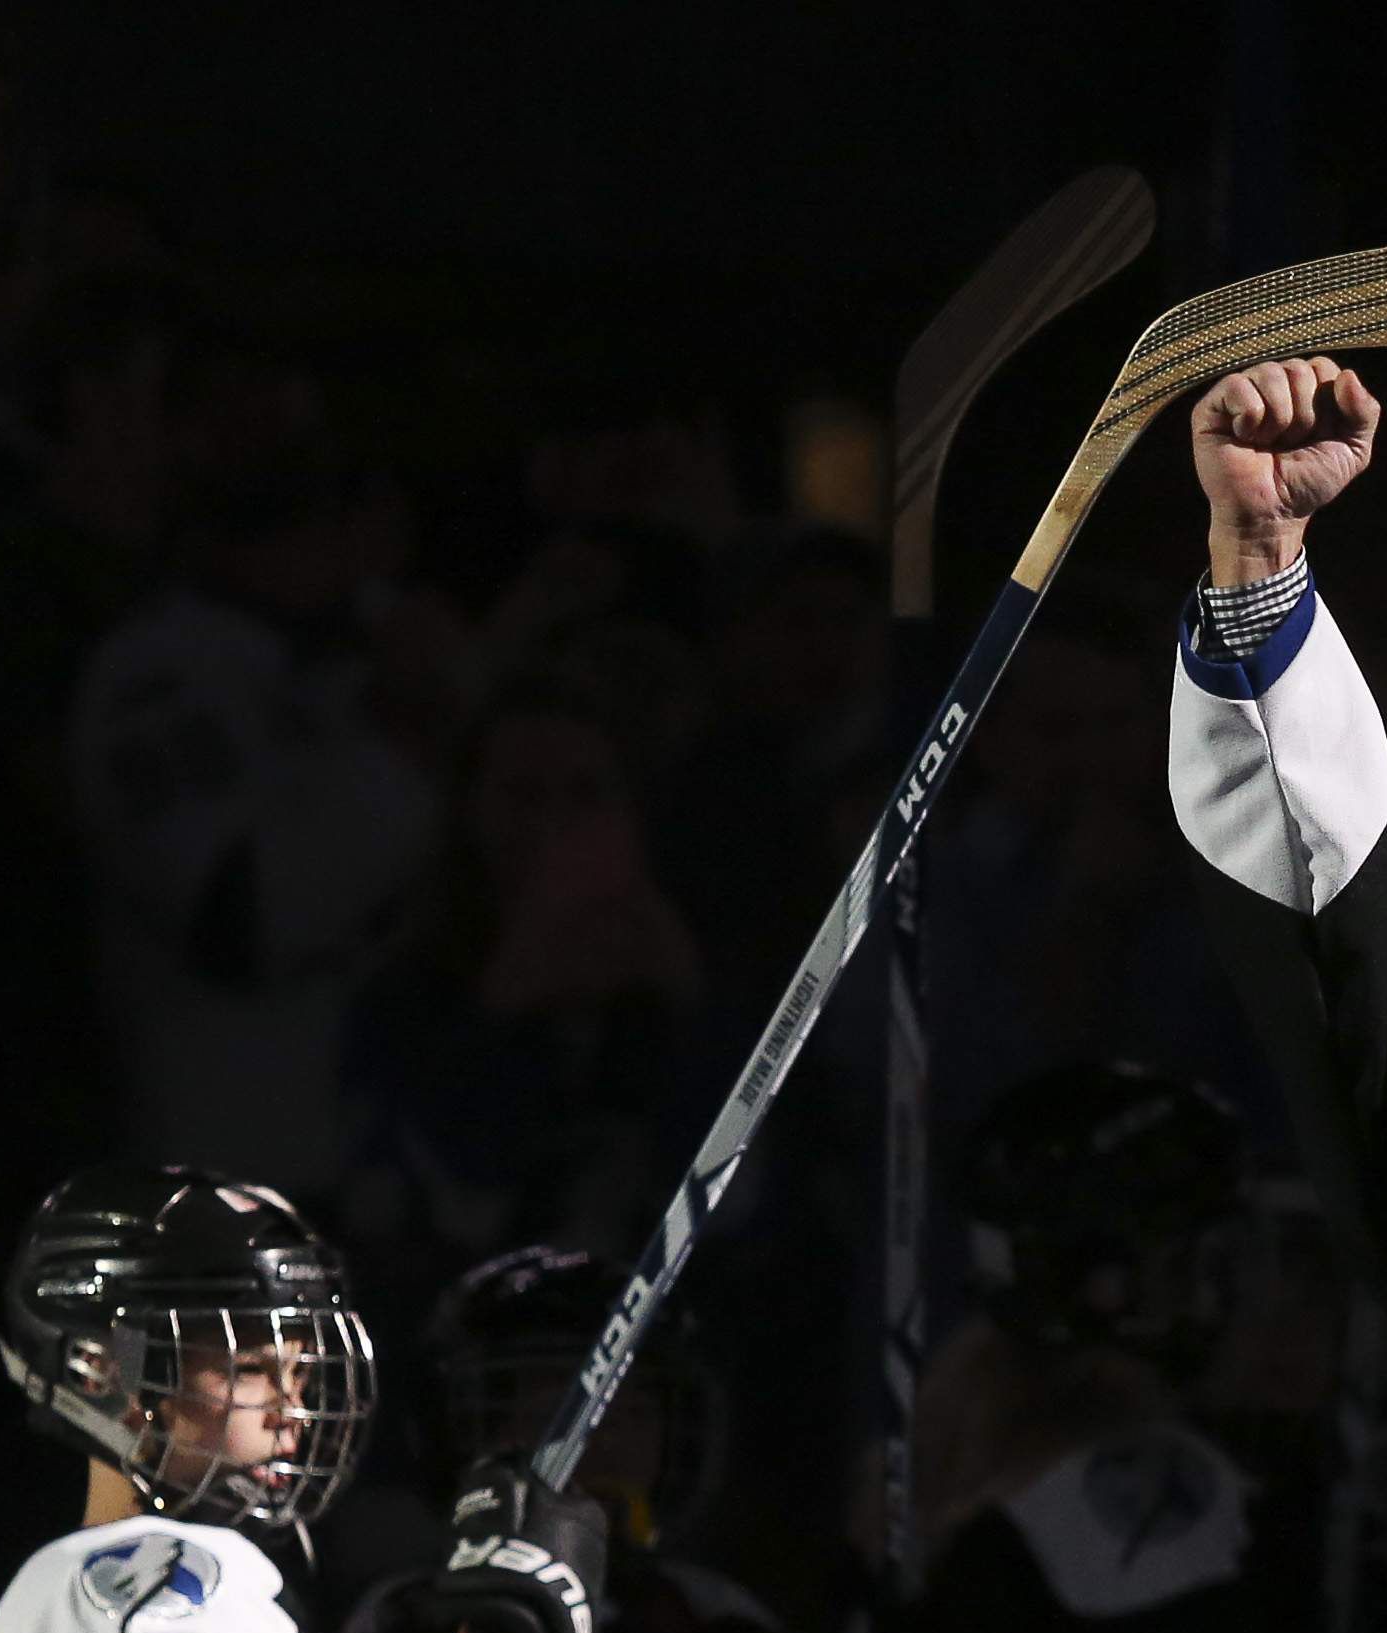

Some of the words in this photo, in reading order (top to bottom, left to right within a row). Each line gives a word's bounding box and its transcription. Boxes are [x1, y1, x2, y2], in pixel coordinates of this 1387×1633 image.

[897, 702, 968, 825] CCM
[764, 970, 820, 1061] LIGHTNING
[738, 1055, 774, 1109] MADE
[580, 1274, 654, 1398] CCM
